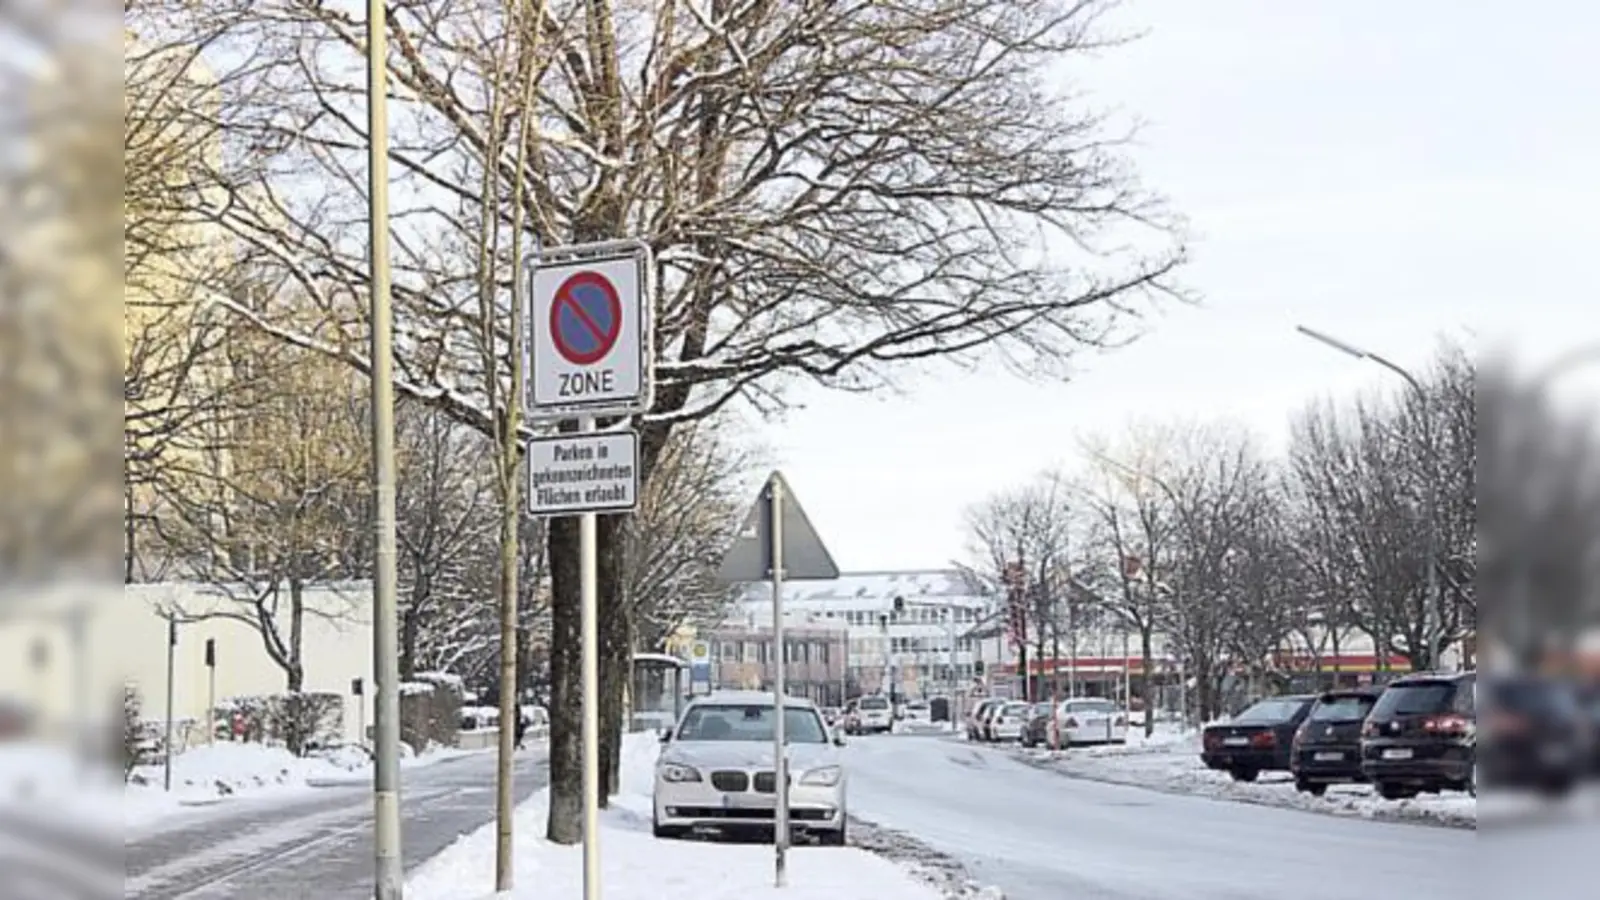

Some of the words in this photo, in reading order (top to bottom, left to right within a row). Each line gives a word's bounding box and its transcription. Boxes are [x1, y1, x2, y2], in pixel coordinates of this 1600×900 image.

[559, 369, 614, 396] ZONE
[554, 444, 593, 461] Parken
[597, 442, 608, 459] in
[585, 484, 626, 502] erlaubt
